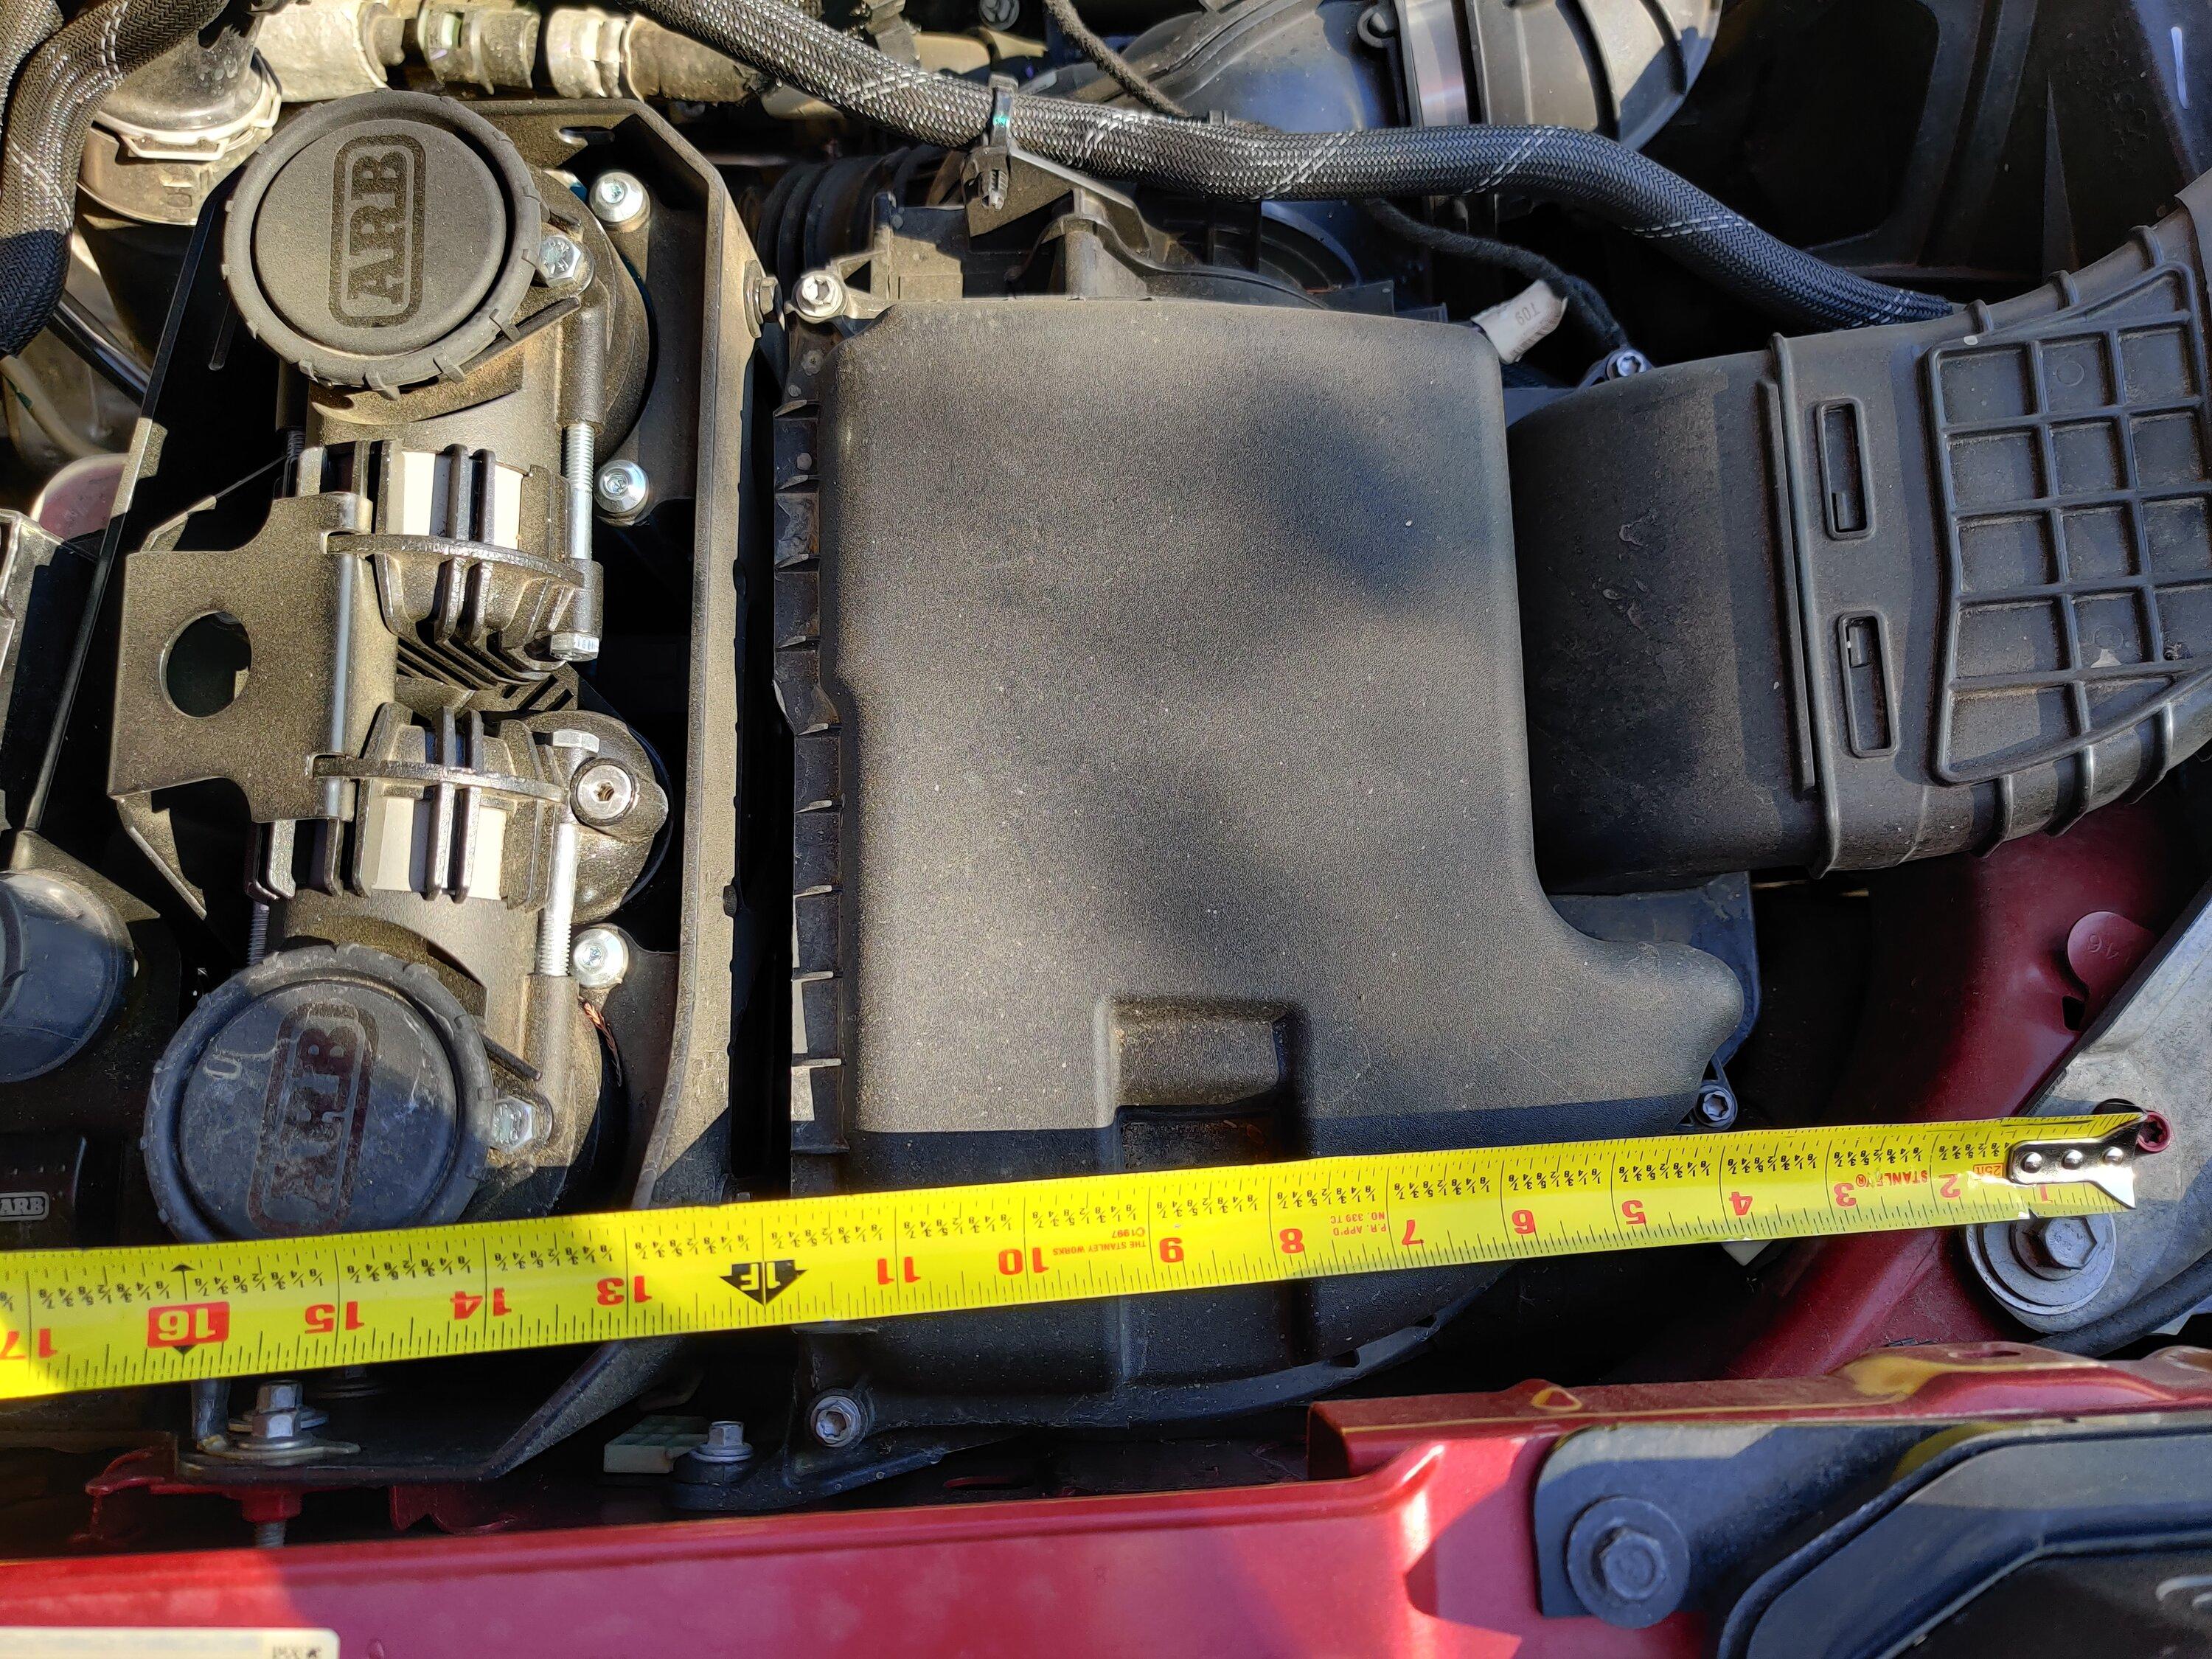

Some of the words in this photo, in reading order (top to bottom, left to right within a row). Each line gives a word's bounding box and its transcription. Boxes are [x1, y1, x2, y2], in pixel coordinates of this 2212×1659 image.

[347, 152, 407, 304] ARB
[271, 1026, 357, 1209] ARB
[1834, 1183, 1857, 1207] 3
[1938, 1174, 1961, 1199] 2
[0, 1197, 44, 1216] ARB
[1621, 1200, 1646, 1225] 5
[1728, 1192, 1753, 1217] 4
[1330, 1215, 1343, 1224] TC
[1512, 1209, 1537, 1235] 6
[1279, 1228, 1304, 1254] 8
[1401, 1219, 1424, 1246] 7
[1052, 1245, 1085, 1256] WORKS
[1088, 1242, 1127, 1252] STANLEY
[1159, 1237, 1184, 1263] 9
[158, 1307, 216, 1341] 16
